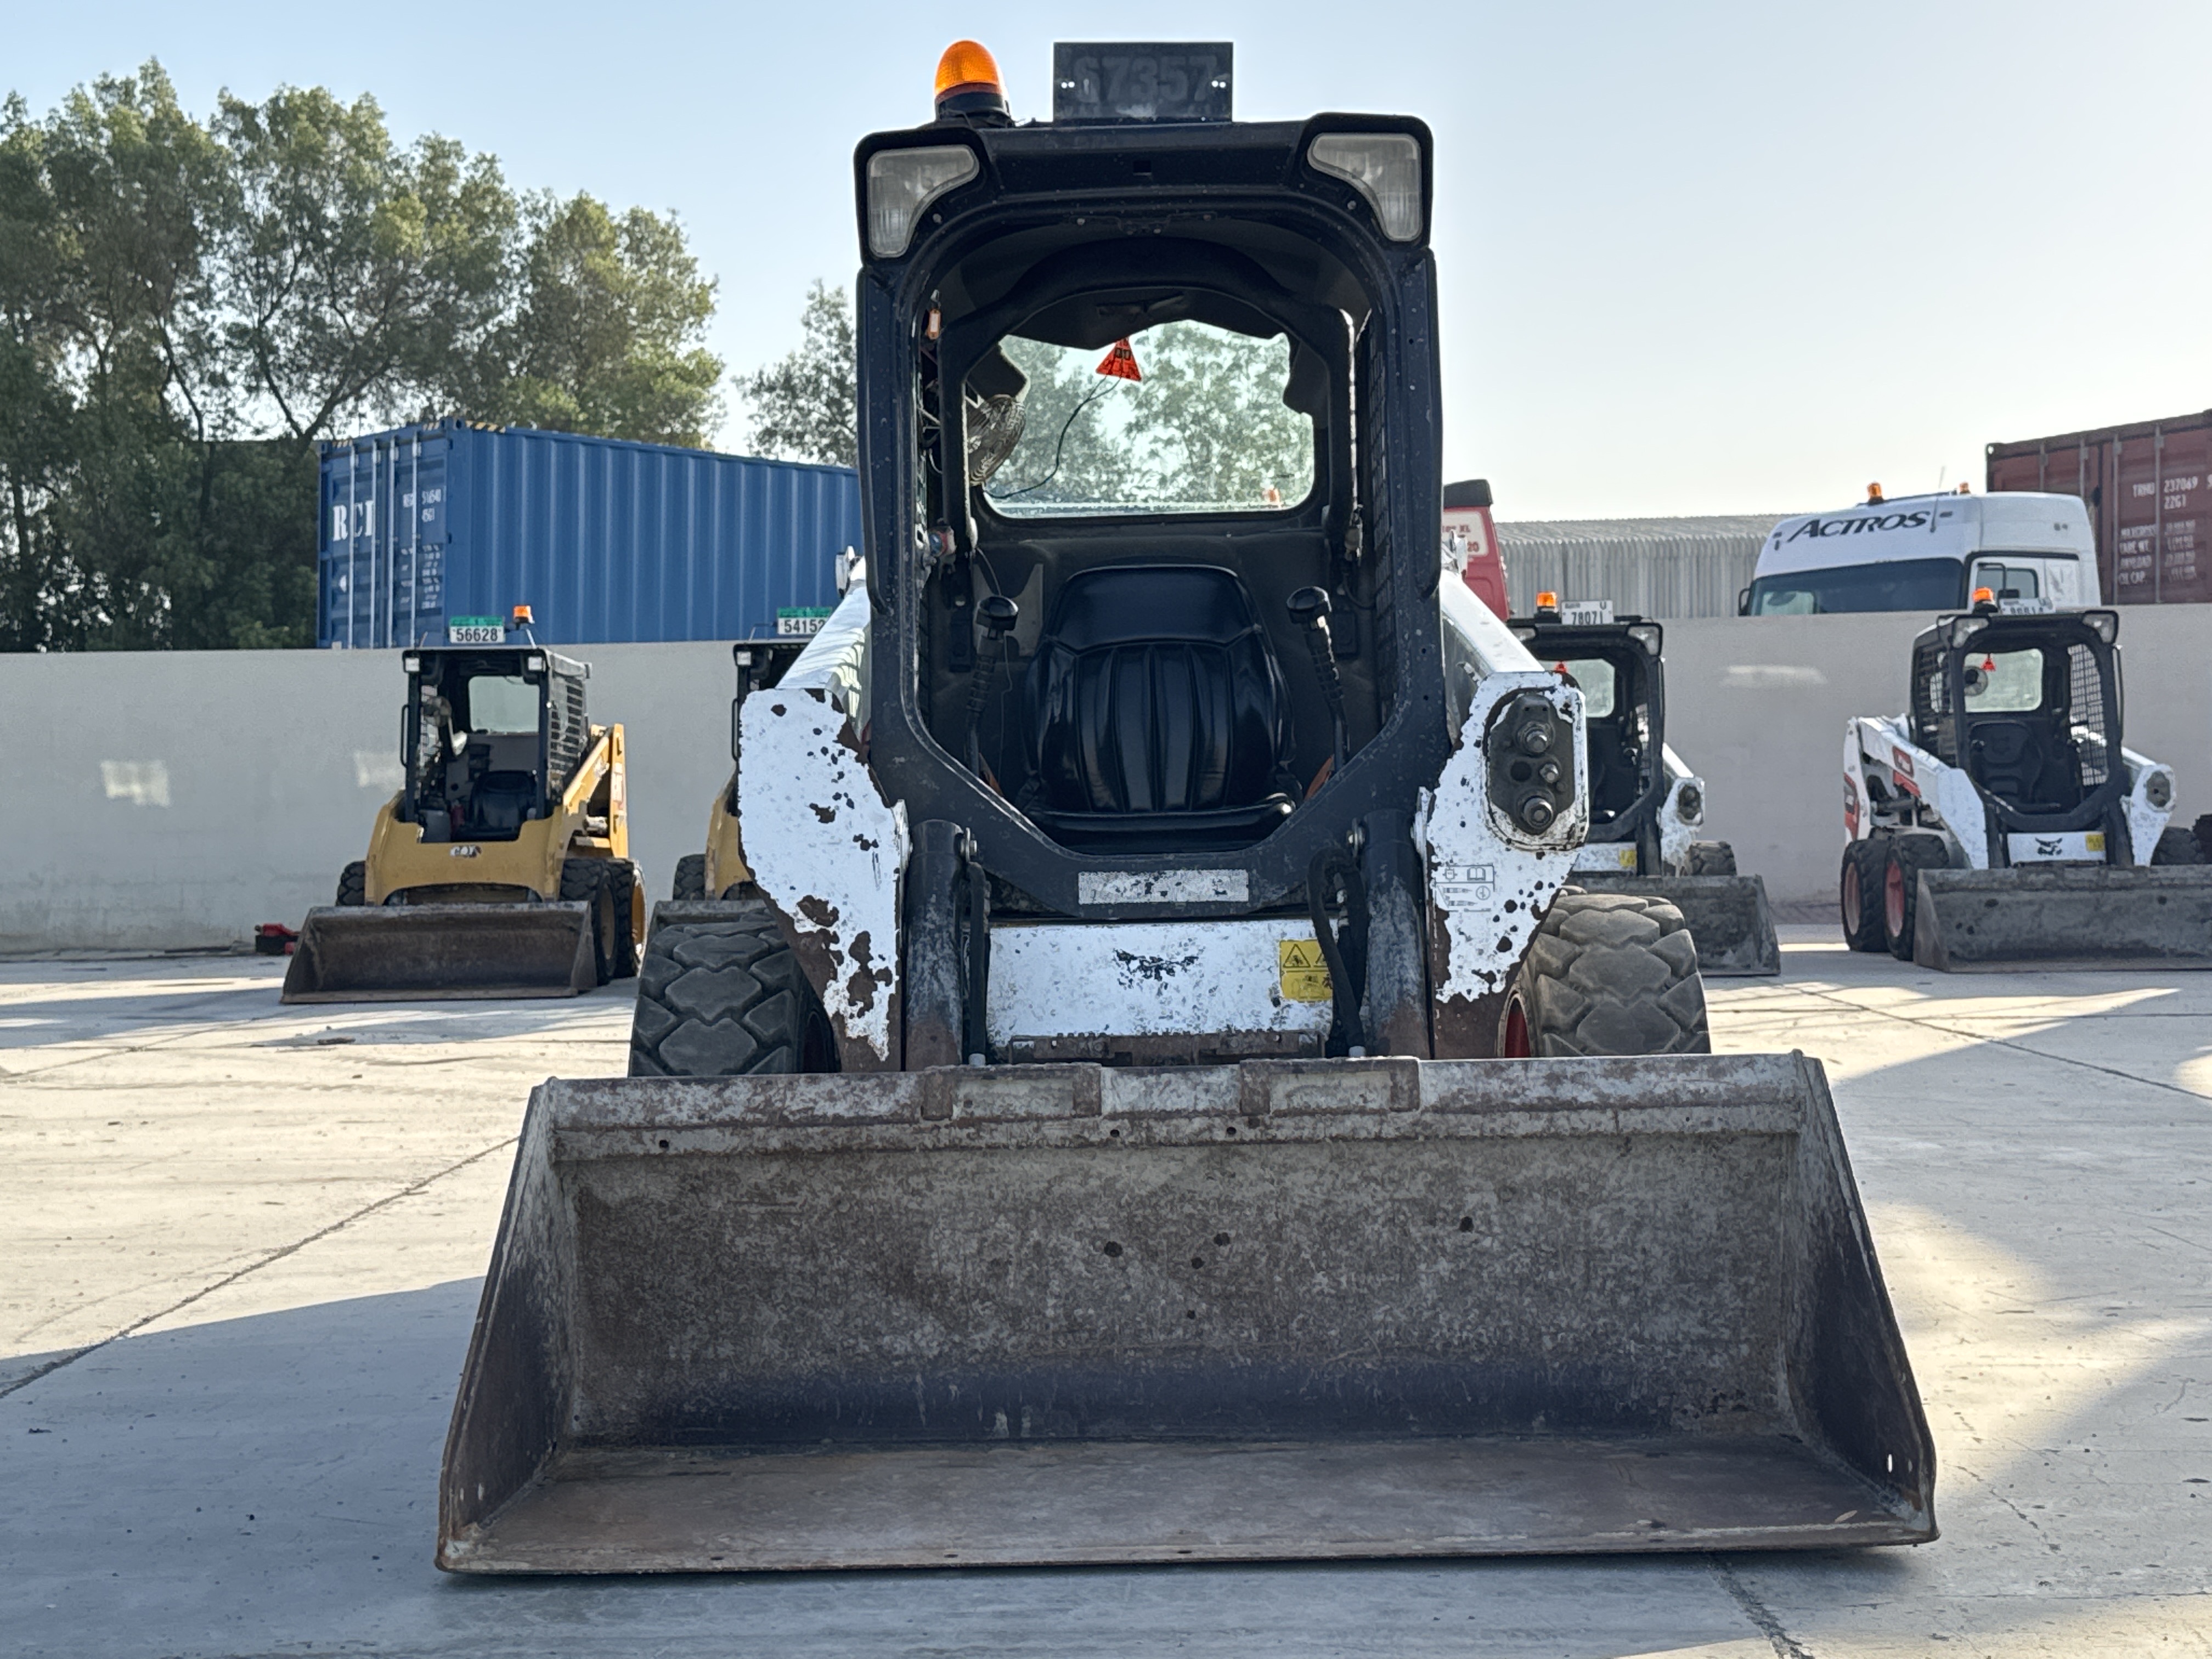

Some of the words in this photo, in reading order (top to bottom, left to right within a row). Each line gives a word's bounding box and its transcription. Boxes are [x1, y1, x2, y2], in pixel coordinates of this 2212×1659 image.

[1787, 511, 1930, 542] ACTROS
[1571, 611, 1603, 625] 78071
[456, 628, 498, 641] 56628
